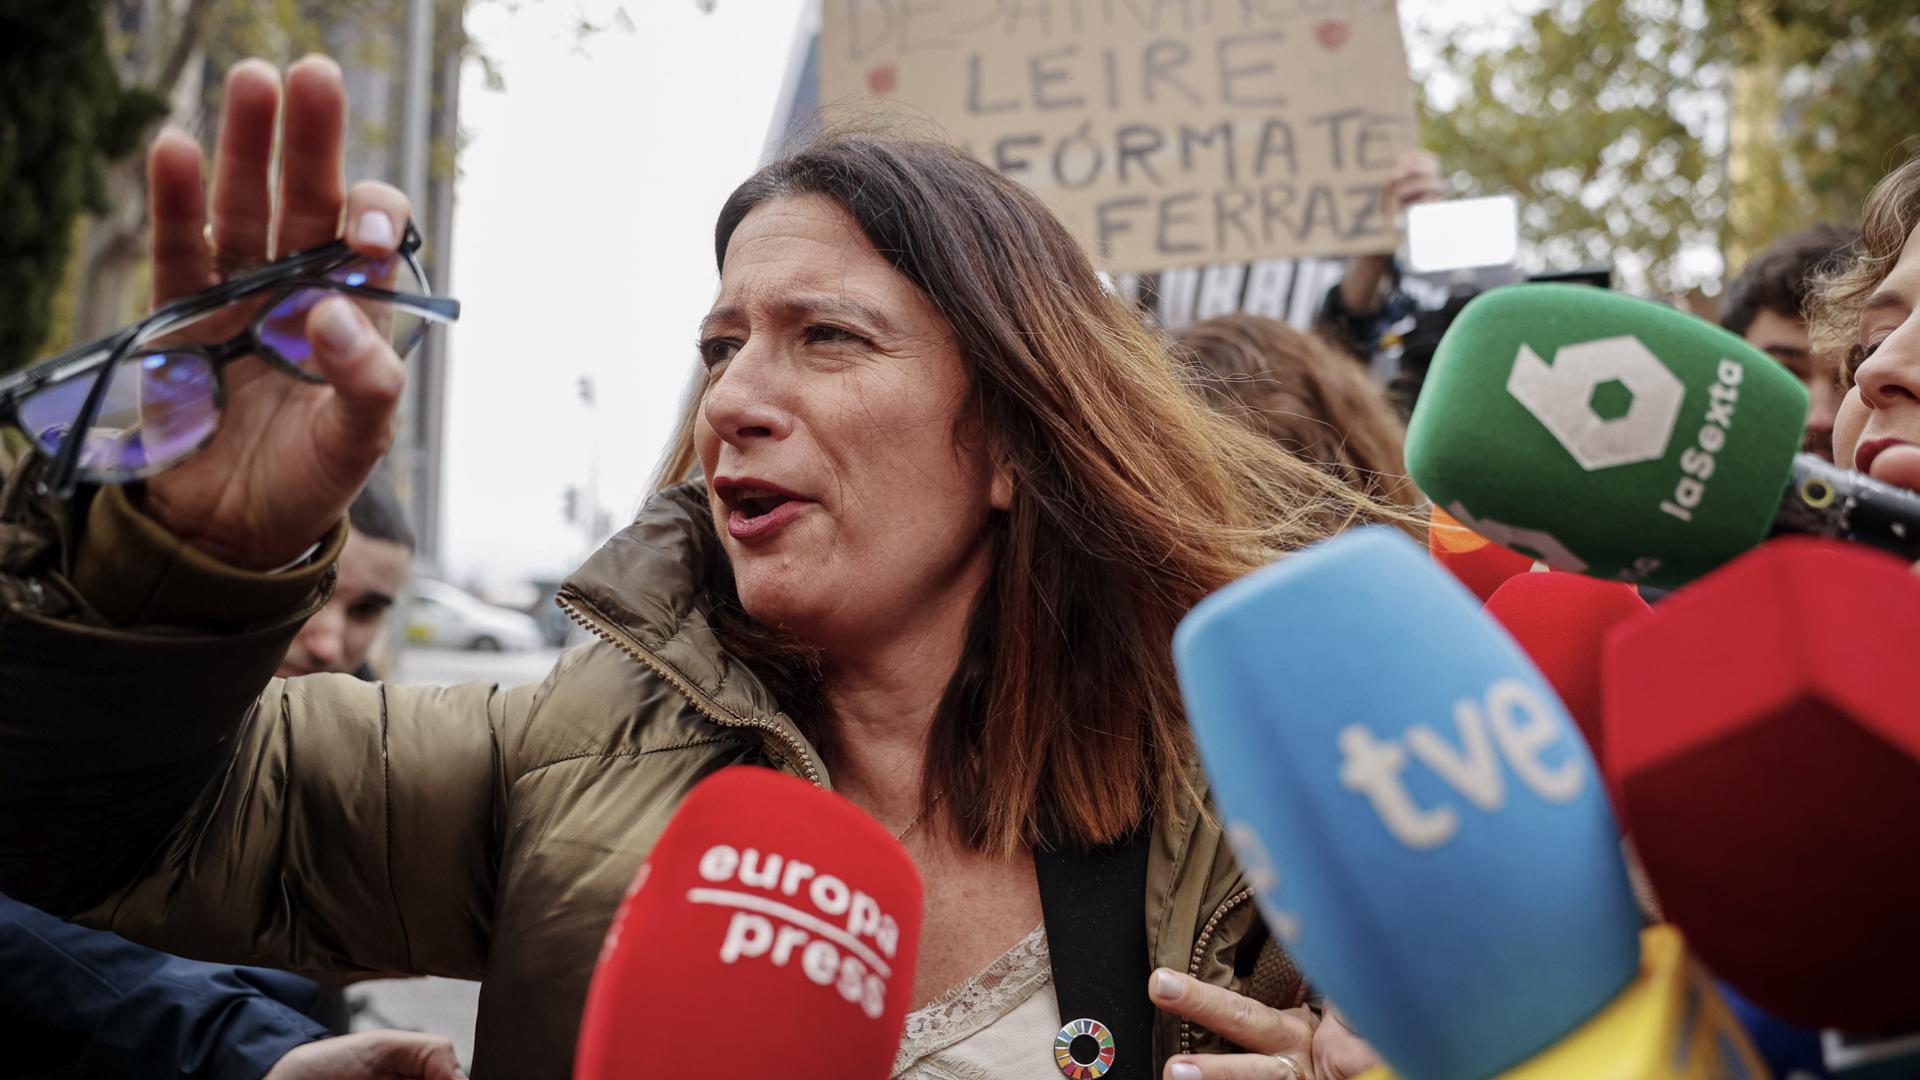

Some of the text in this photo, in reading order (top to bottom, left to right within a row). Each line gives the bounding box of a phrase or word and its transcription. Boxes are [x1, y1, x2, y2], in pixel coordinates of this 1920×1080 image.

[965, 31, 1288, 115] LEIRE
[961, 108, 1409, 191] FÓRMATE
[1096, 182, 1388, 259] FERRAZ
[1659, 358, 1744, 522] laSexta
[1338, 677, 1586, 850] tve
[699, 844, 899, 960] europa
[719, 911, 886, 1019] press
